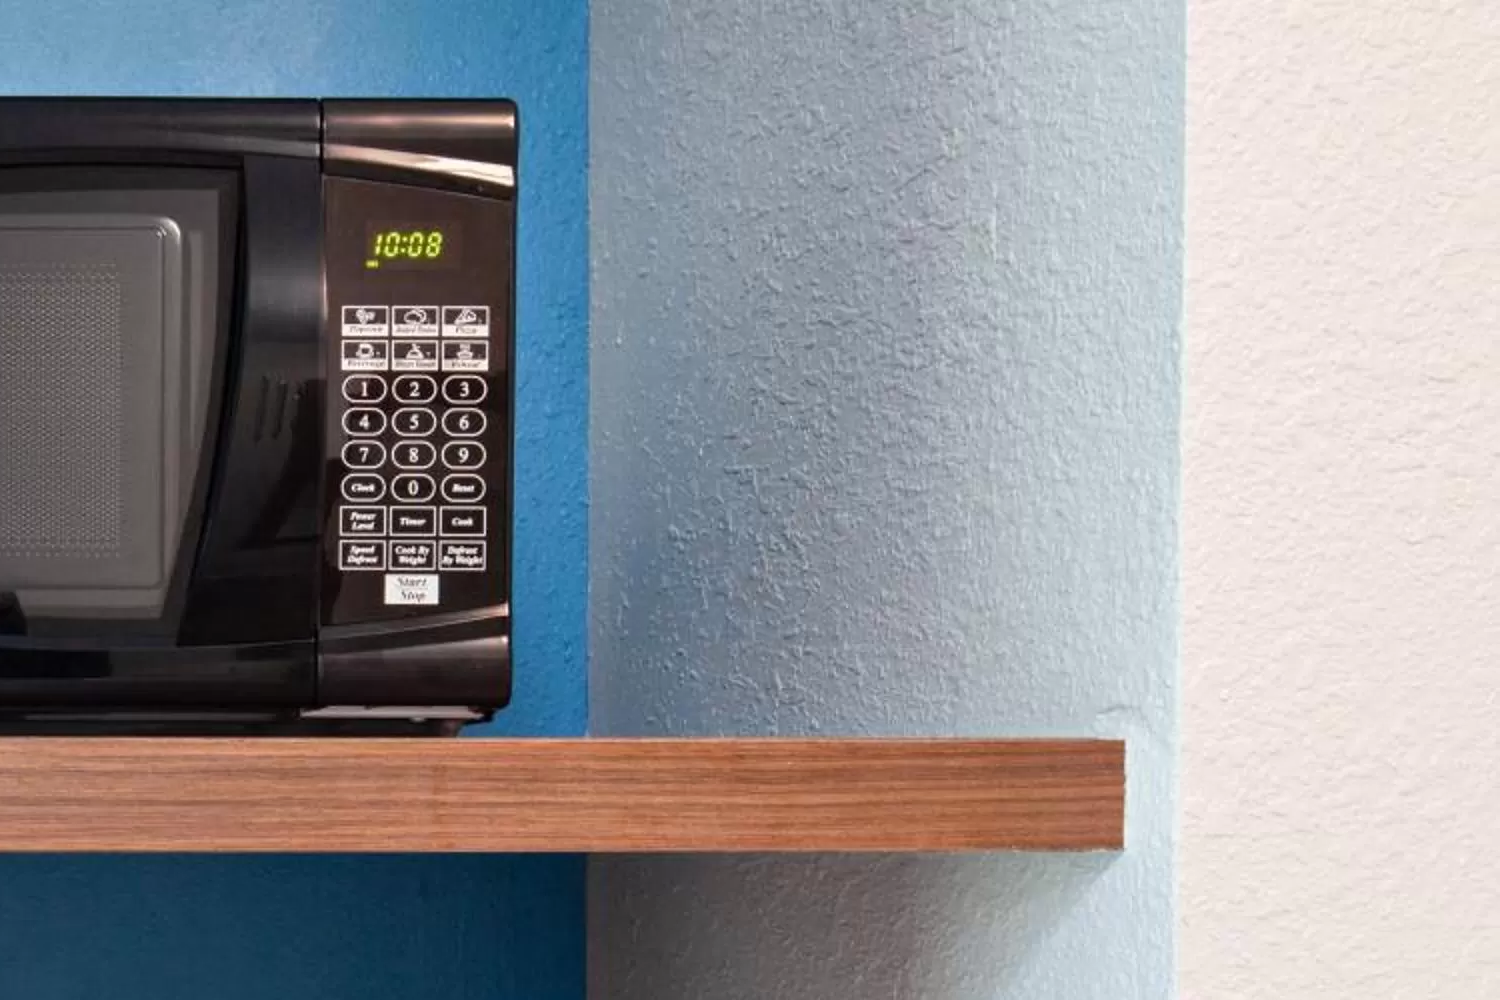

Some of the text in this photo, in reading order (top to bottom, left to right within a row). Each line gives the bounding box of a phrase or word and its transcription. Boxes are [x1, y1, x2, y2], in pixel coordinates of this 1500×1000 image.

[374, 231, 443, 258] 10:08
[360, 381, 369, 397] 1
[409, 381, 420, 397] 2
[459, 381, 470, 397] 3
[359, 414, 370, 430] 4
[409, 414, 419, 429] 5
[458, 415, 469, 430] 6
[359, 447, 370, 463] 7
[408, 447, 419, 463] 8
[458, 447, 469, 464] 9
[351, 482, 376, 493] Clock
[408, 480, 419, 496] 0
[400, 517, 427, 526] Timer
[397, 577, 429, 587] Start
[400, 590, 426, 603] Stop
